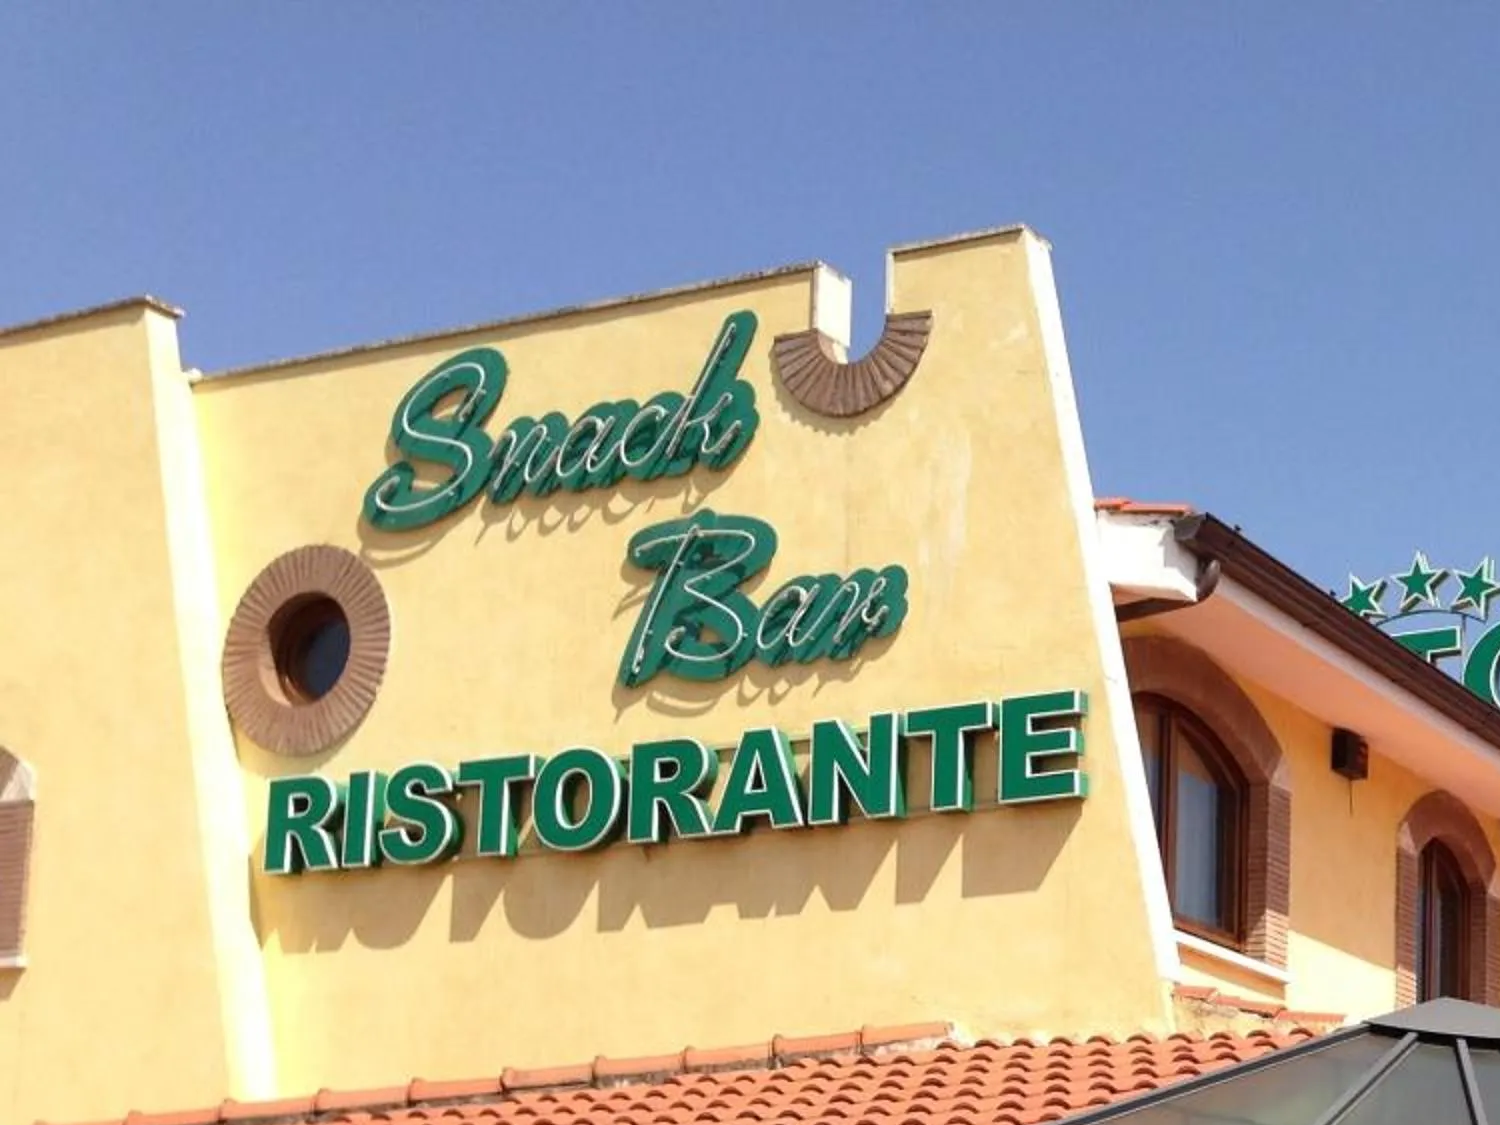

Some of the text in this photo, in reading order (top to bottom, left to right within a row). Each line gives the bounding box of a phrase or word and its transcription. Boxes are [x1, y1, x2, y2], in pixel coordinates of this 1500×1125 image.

[363, 309, 759, 532] Snack
[616, 509, 910, 688] Bar
[263, 690, 1089, 874] RISTORANTE
